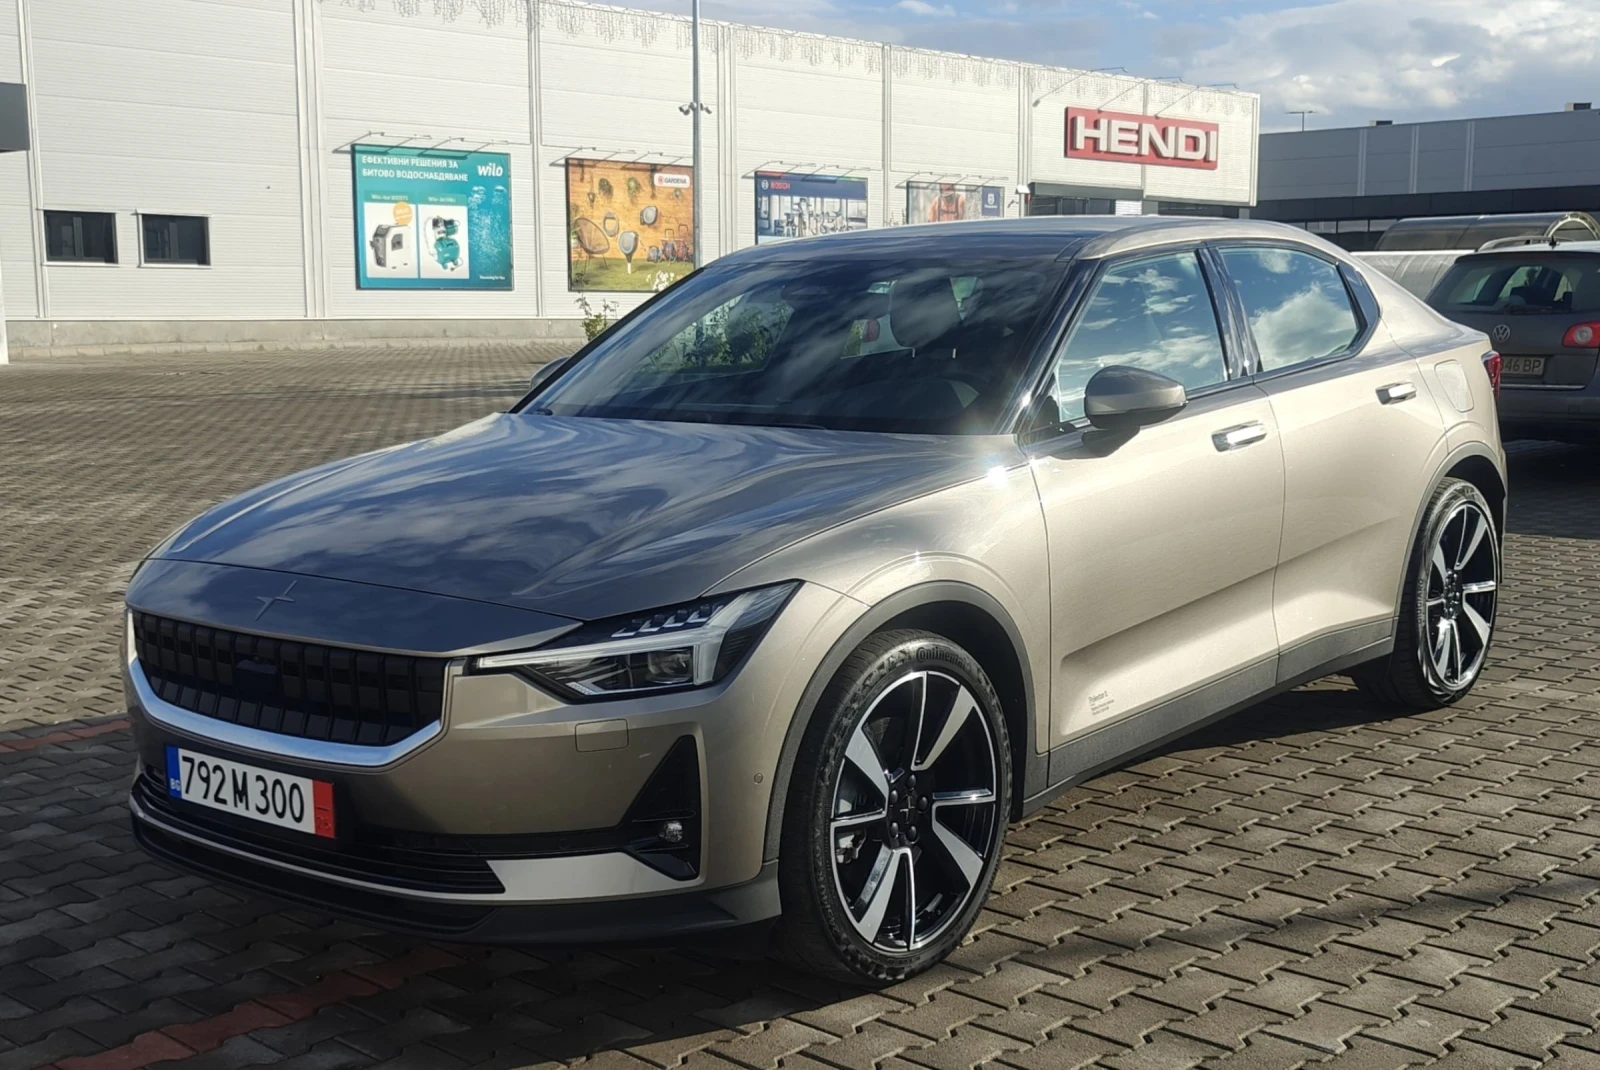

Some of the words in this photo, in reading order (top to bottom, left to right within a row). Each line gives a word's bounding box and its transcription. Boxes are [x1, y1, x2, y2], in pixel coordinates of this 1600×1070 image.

[1075, 115, 1218, 162] HENDI
[361, 155, 410, 167] ЕФЕКТИВНИ
[410, 157, 447, 169] РЕШЕНИЯ
[448, 160, 459, 169] ЗА
[361, 168, 395, 178] БИТОВО
[396, 169, 469, 182] ВОДОСНАБДЯВАНЕ
[476, 162, 504, 177] wilo
[1502, 358, 1521, 372] 46
[169, 777, 182, 792] BG
